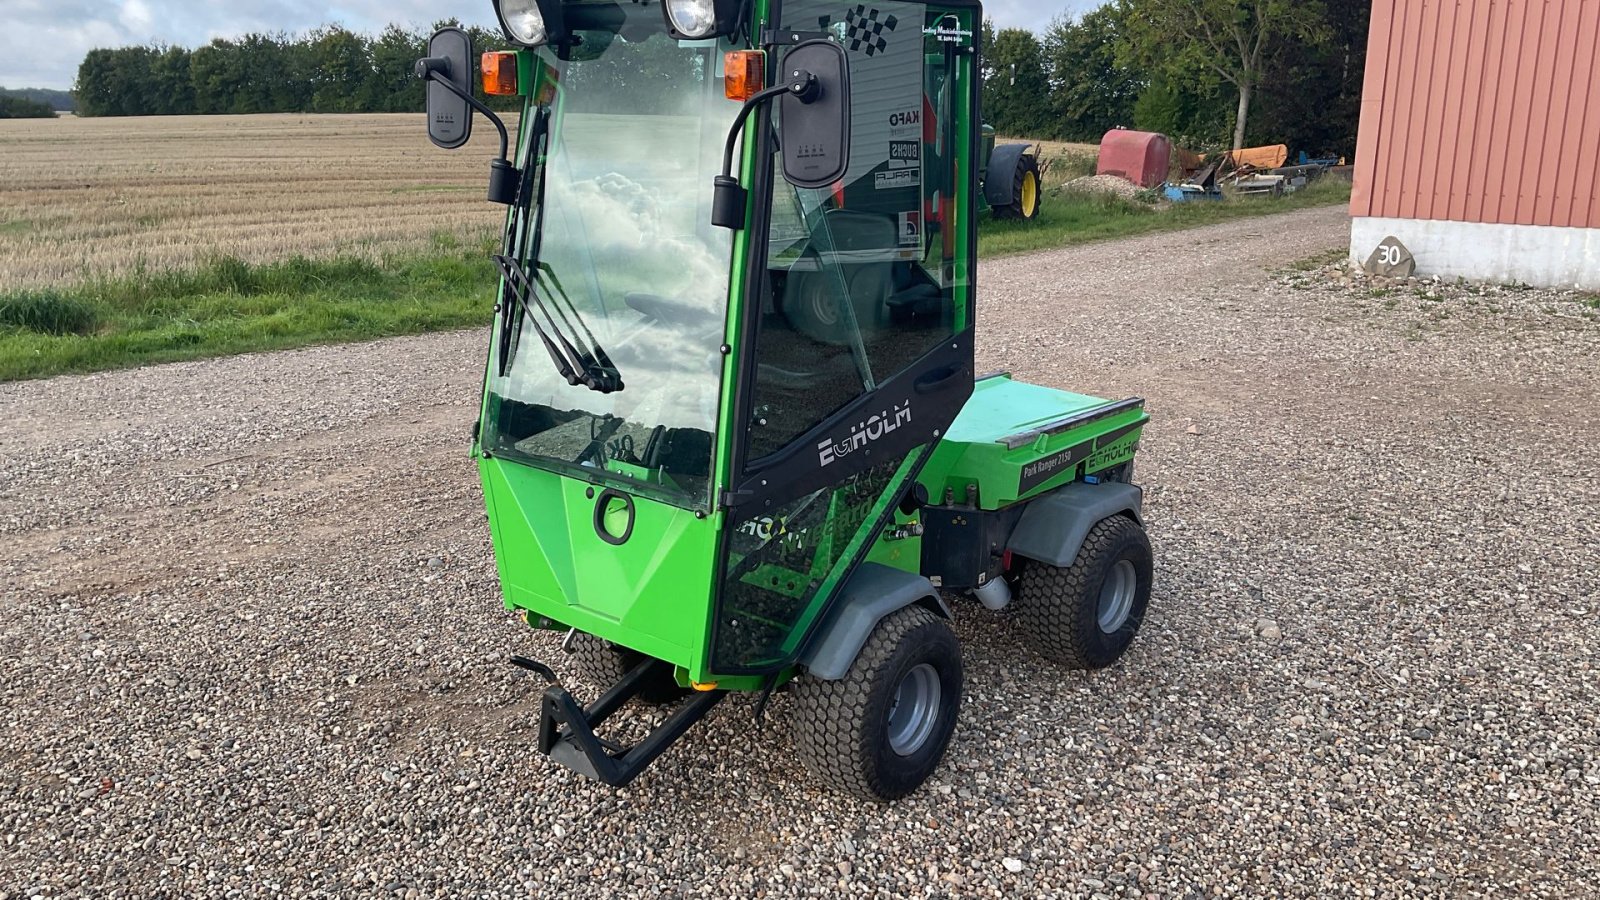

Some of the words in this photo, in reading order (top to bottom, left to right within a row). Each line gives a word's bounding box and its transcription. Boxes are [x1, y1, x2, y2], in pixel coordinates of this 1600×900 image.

[1377, 245, 1401, 266] 30
[1024, 463, 1038, 478] Park
[1037, 457, 1058, 472] Ranger
